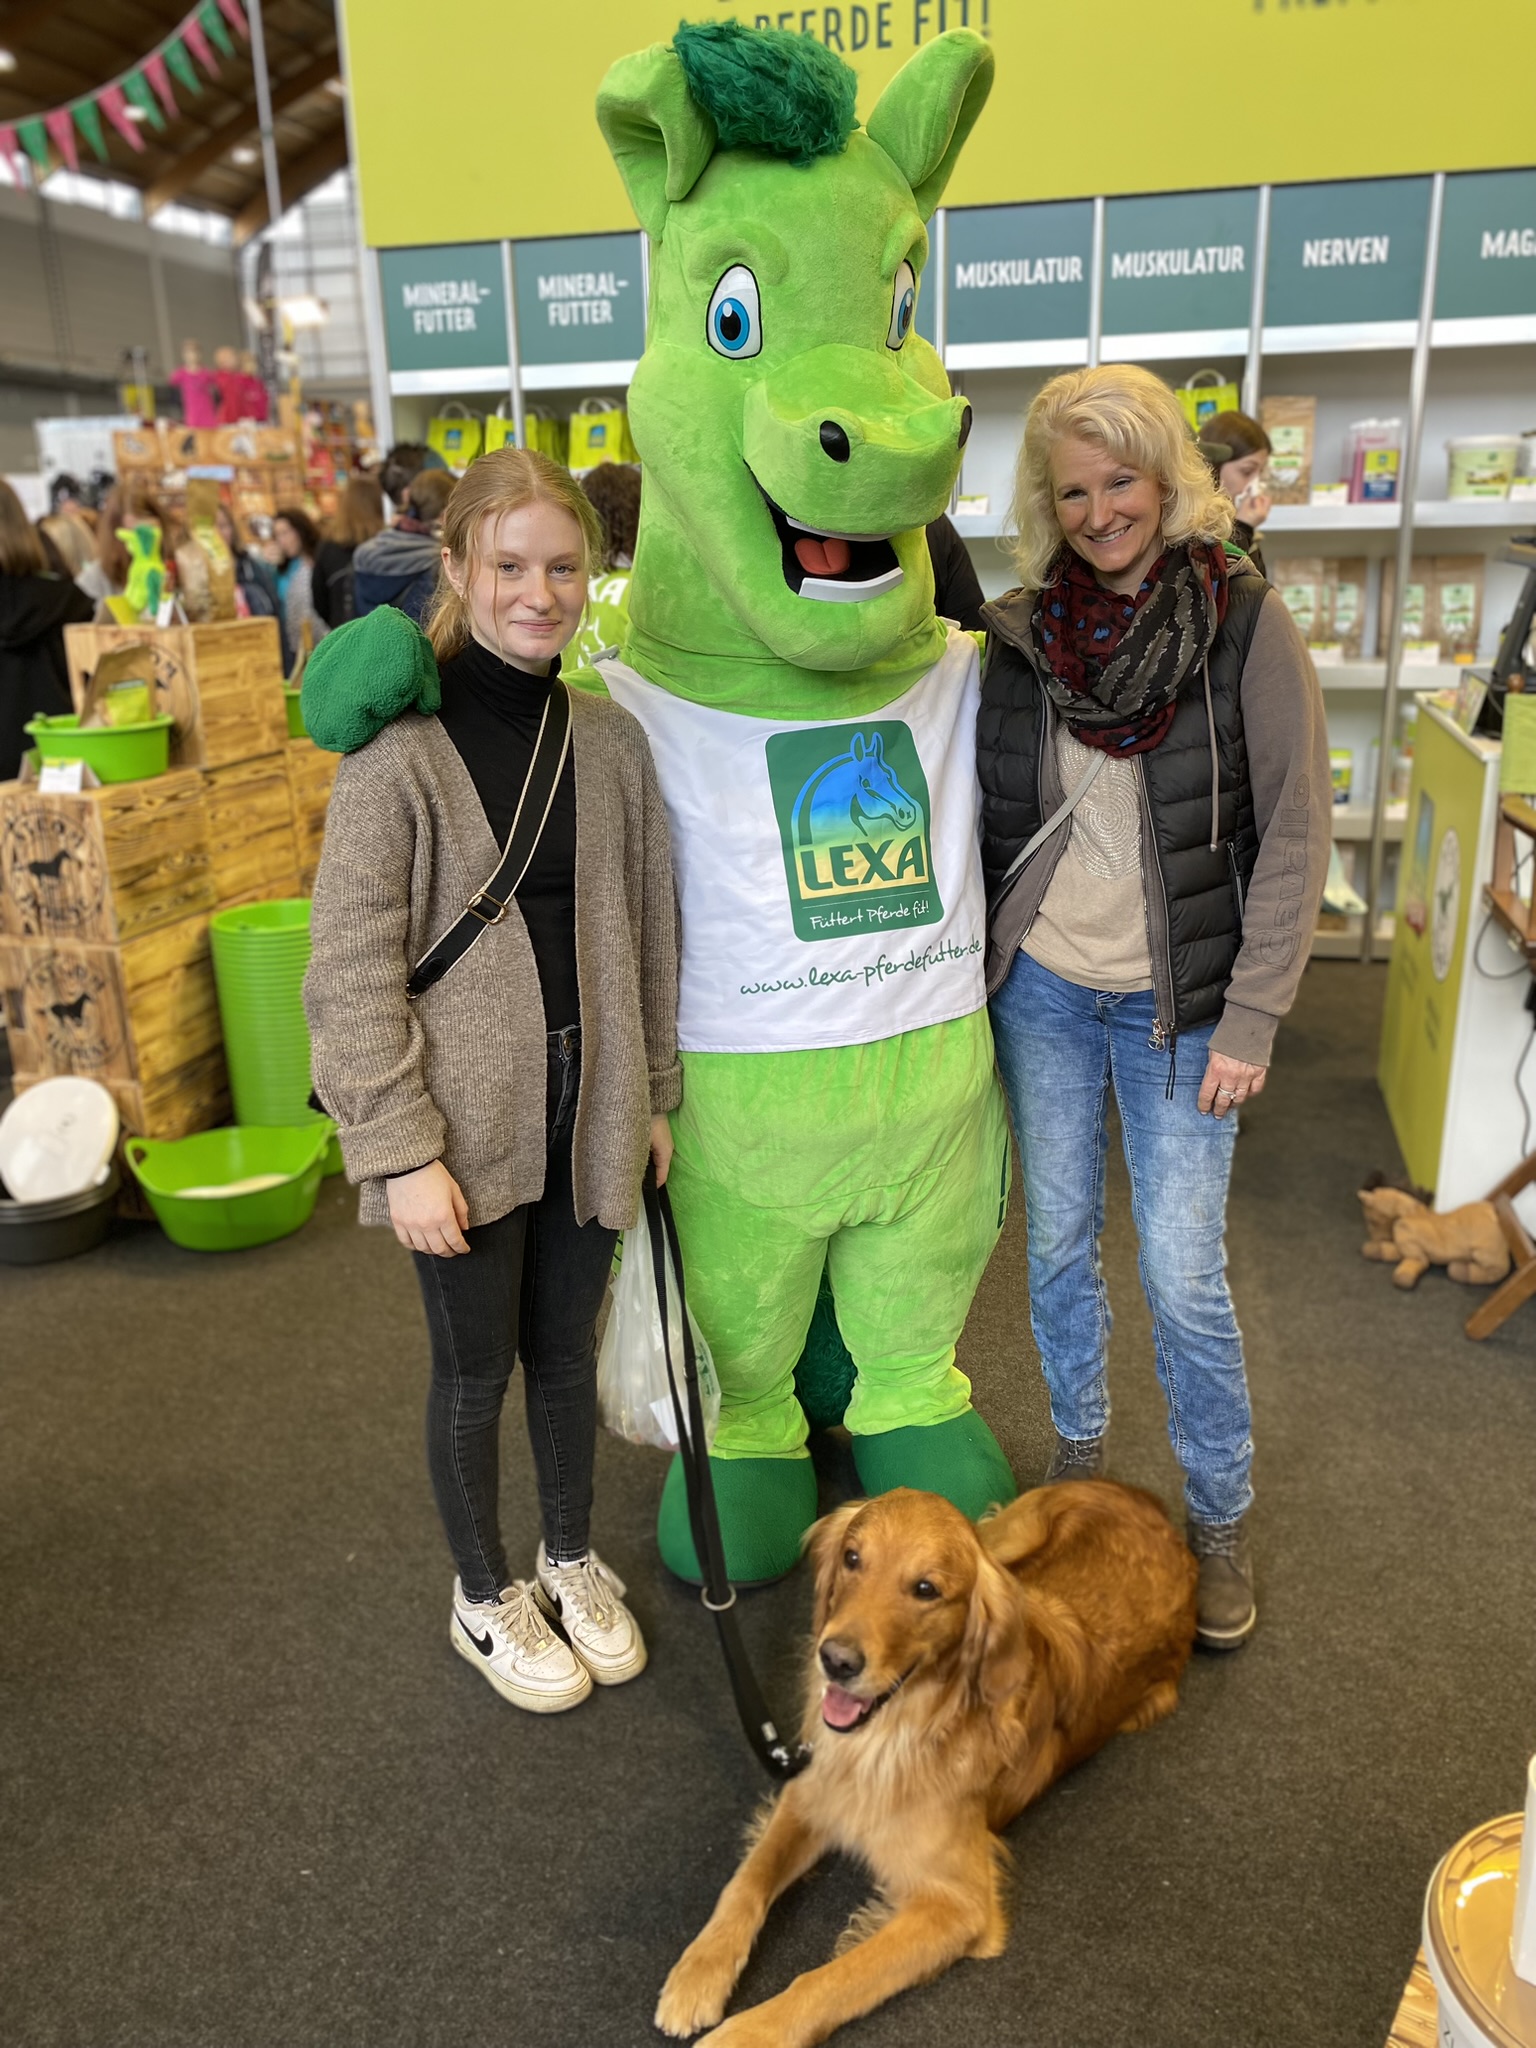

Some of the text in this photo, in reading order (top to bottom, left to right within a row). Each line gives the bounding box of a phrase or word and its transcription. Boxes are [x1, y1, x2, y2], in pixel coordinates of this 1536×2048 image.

[1302, 235, 1389, 268] NERVEN
[1480, 228, 1536, 260] MAG
[956, 256, 1083, 289] MUSKULATUR
[1111, 245, 1245, 279] MUSKULATUR
[402, 280, 491, 308] MINERAL-
[537, 272, 629, 300] MINERAL-
[413, 307, 477, 334] FUTTER
[547, 299, 613, 326] FUTTER
[801, 836, 925, 890] LEXA
[809, 900, 931, 930] Füttert Pferde fit!
[740, 935, 982, 994] www.lexa-pferdefutter.de
